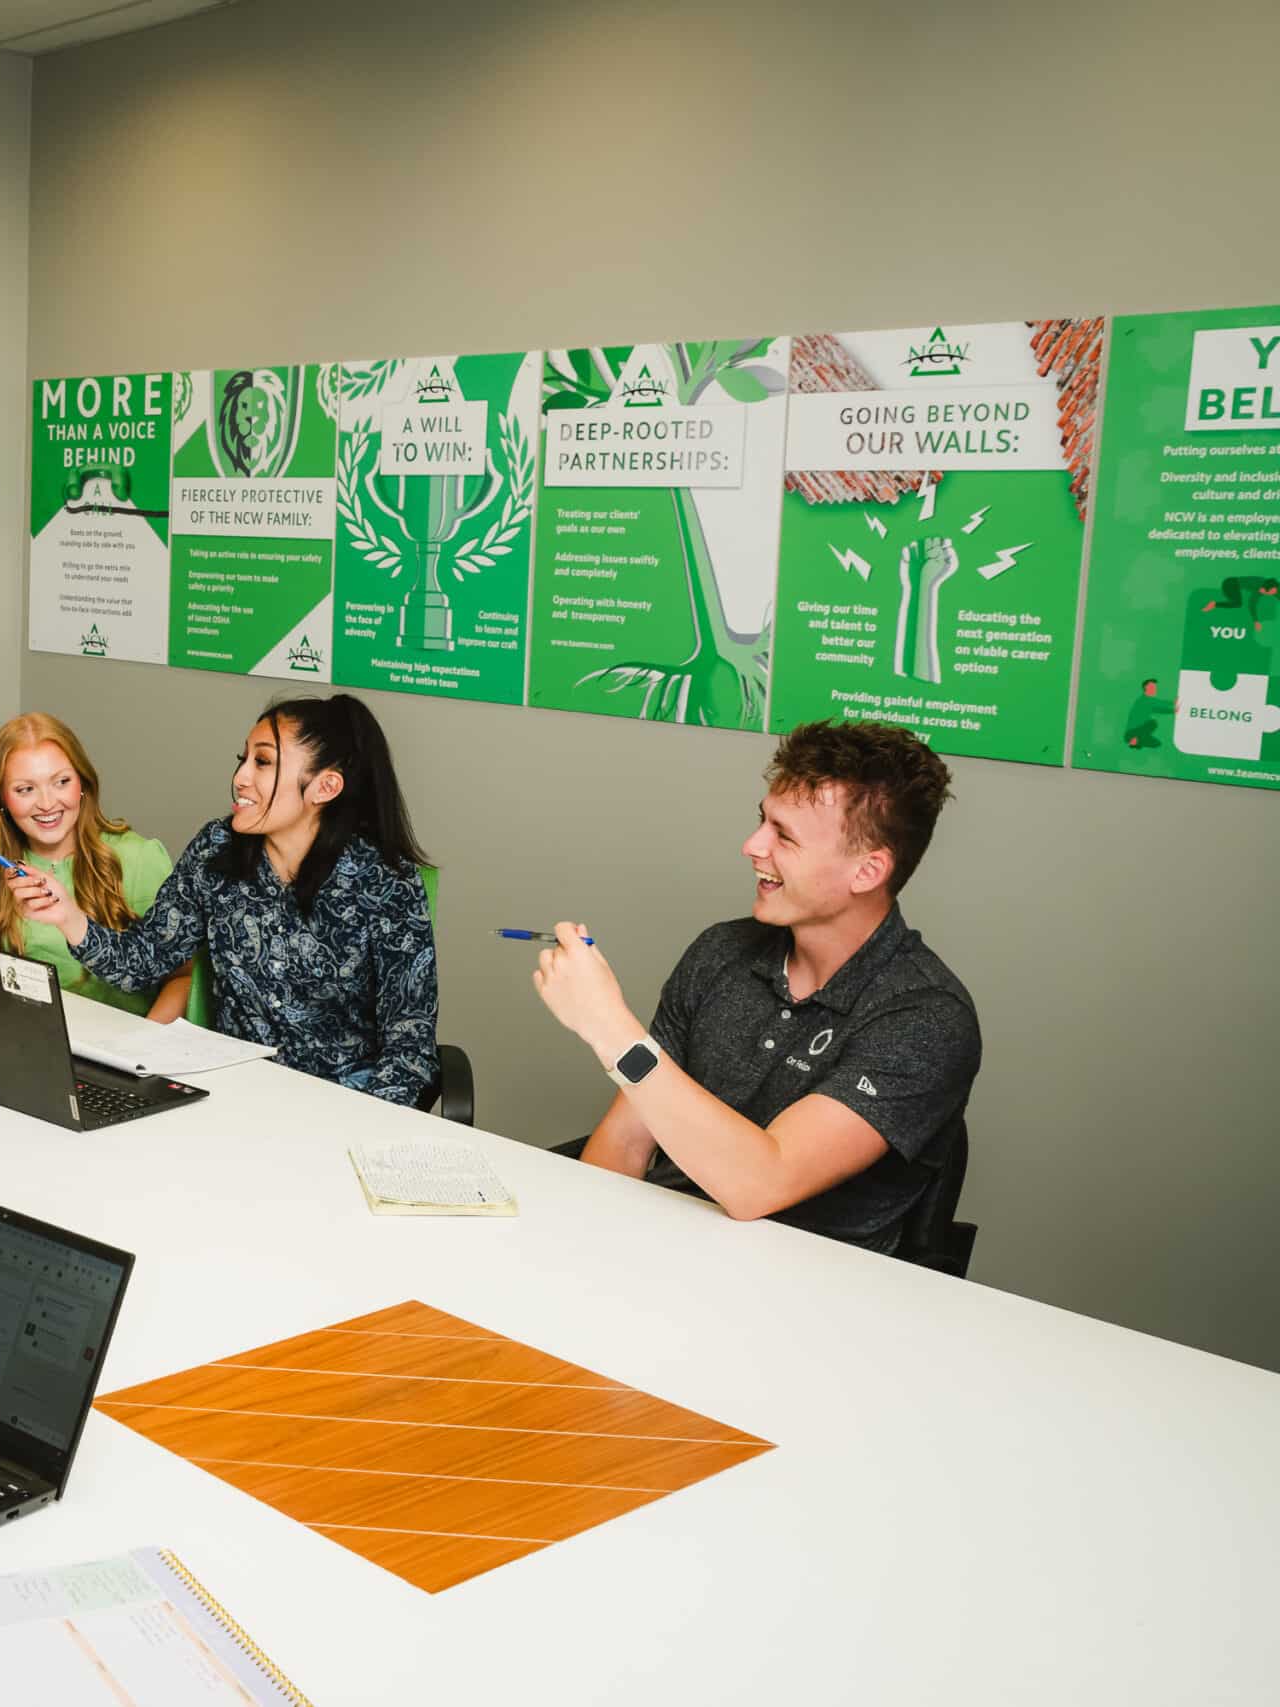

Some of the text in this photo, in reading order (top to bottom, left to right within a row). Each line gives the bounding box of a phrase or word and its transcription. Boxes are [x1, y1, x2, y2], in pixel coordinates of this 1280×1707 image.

[907, 343, 970, 364] NCW
[417, 378, 454, 394] NCW
[623, 379, 670, 398] NCW
[42, 374, 162, 419] MORE
[839, 401, 1030, 425] GOING BEYOND
[47, 421, 156, 441] THAN A VOICE
[402, 416, 463, 433] A WILL
[559, 420, 714, 442] DEEP-ROOTED
[845, 428, 1020, 454] OUR WALLS:
[63, 446, 136, 467] BEHIND
[392, 441, 472, 462] TO WIN:
[1163, 445, 1207, 459] Putting
[1209, 445, 1267, 456] ourselves
[558, 450, 729, 471] PARTNERSHIPS:
[1160, 471, 1212, 485] Diversity
[1214, 471, 1237, 483] and
[181, 489, 323, 504] FIERCELY PROTECTIVE
[1192, 489, 1235, 501] culture
[1237, 489, 1261, 501] and
[190, 510, 312, 527] OF THE NCW FAMILY:
[557, 508, 640, 521] Treating our clients'
[1164, 511, 1196, 523] NCW
[1198, 511, 1207, 523] is
[1209, 514, 1225, 523] an
[556, 523, 578, 535] goals
[591, 525, 606, 534] our
[607, 526, 625, 534] own
[1148, 528, 1279, 544] dedicated to elevating
[189, 549, 208, 559] Taking
[302, 553, 321, 564] safety
[555, 552, 659, 568] Addressing issues swiftly
[1174, 546, 1240, 561] employees,
[554, 567, 617, 581] and completely
[552, 594, 652, 612] Operating with honesty
[798, 601, 878, 616] Giving our time
[344, 614, 382, 625] the face of
[478, 610, 519, 624] Continuing
[552, 610, 626, 625] and transparency
[958, 610, 1041, 626] Educating the
[475, 624, 518, 636] to learn and
[808, 618, 877, 632] and talent to
[1209, 625, 1247, 640] YOU
[344, 628, 376, 640] adversity
[822, 634, 876, 648] better our
[956, 629, 1053, 644] next generation
[457, 637, 518, 649] improve our craft
[288, 647, 322, 662] NCW
[815, 652, 874, 668] community
[954, 646, 1050, 661] on viable career
[371, 659, 480, 677] Maintaining high expectations
[953, 661, 999, 675] options
[390, 673, 459, 689] for the entire team
[831, 689, 998, 716] Providing gainful employment
[843, 706, 981, 731] for individuals across the
[1189, 706, 1253, 723] BELONG
